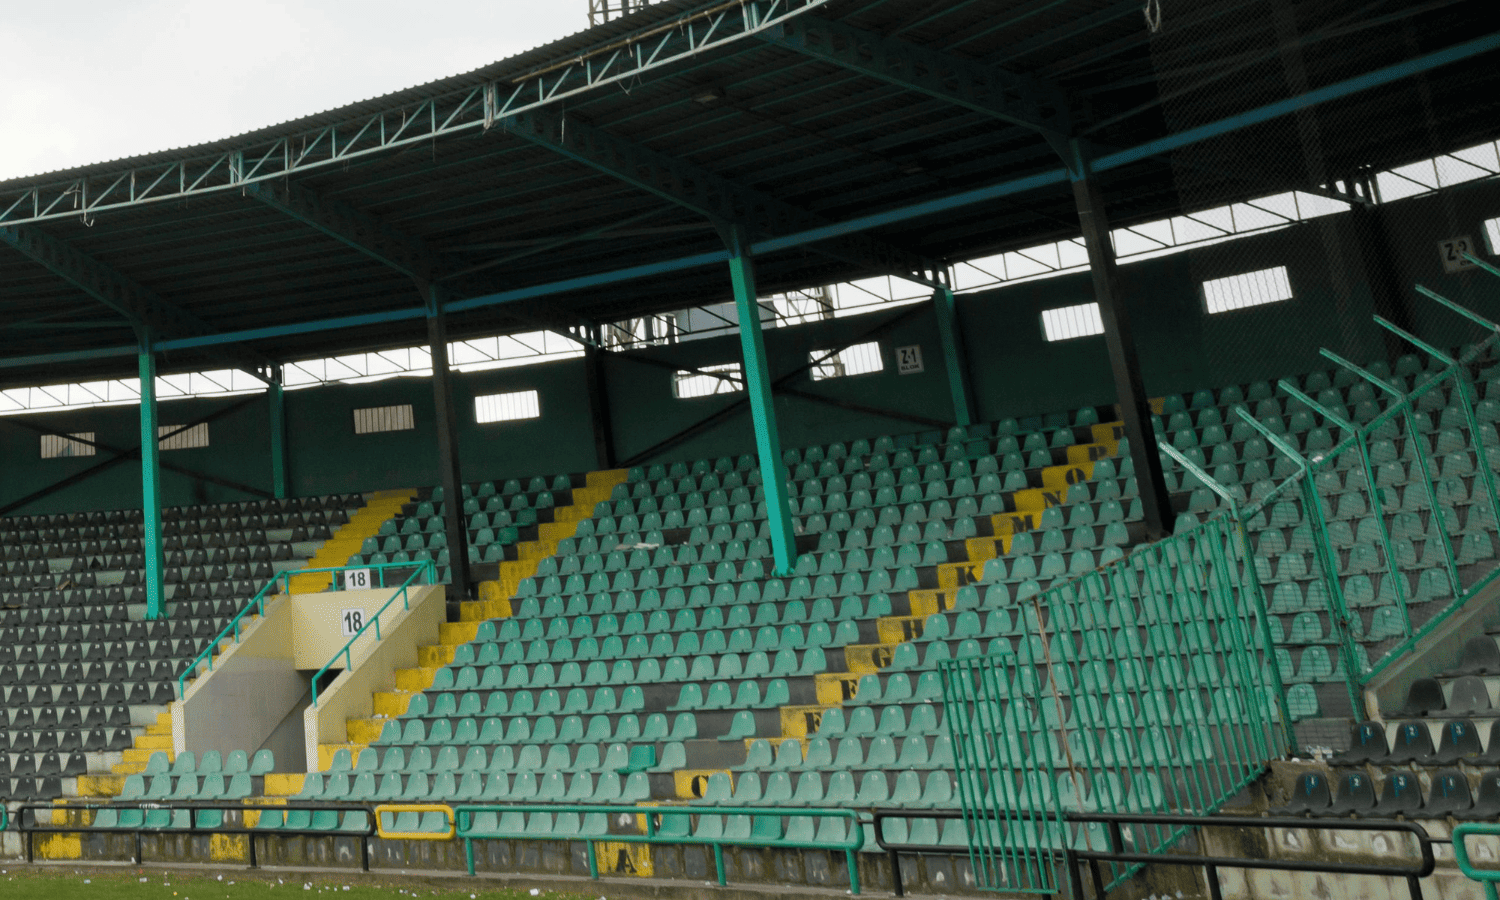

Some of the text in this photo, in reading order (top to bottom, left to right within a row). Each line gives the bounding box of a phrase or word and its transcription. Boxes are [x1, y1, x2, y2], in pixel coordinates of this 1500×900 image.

[1065, 468, 1085, 485] O
[1042, 490, 1062, 506] N
[349, 571, 366, 587] 18
[956, 565, 978, 585] K
[344, 611, 363, 633] 18
[871, 647, 892, 668] G
[616, 849, 638, 874] A
